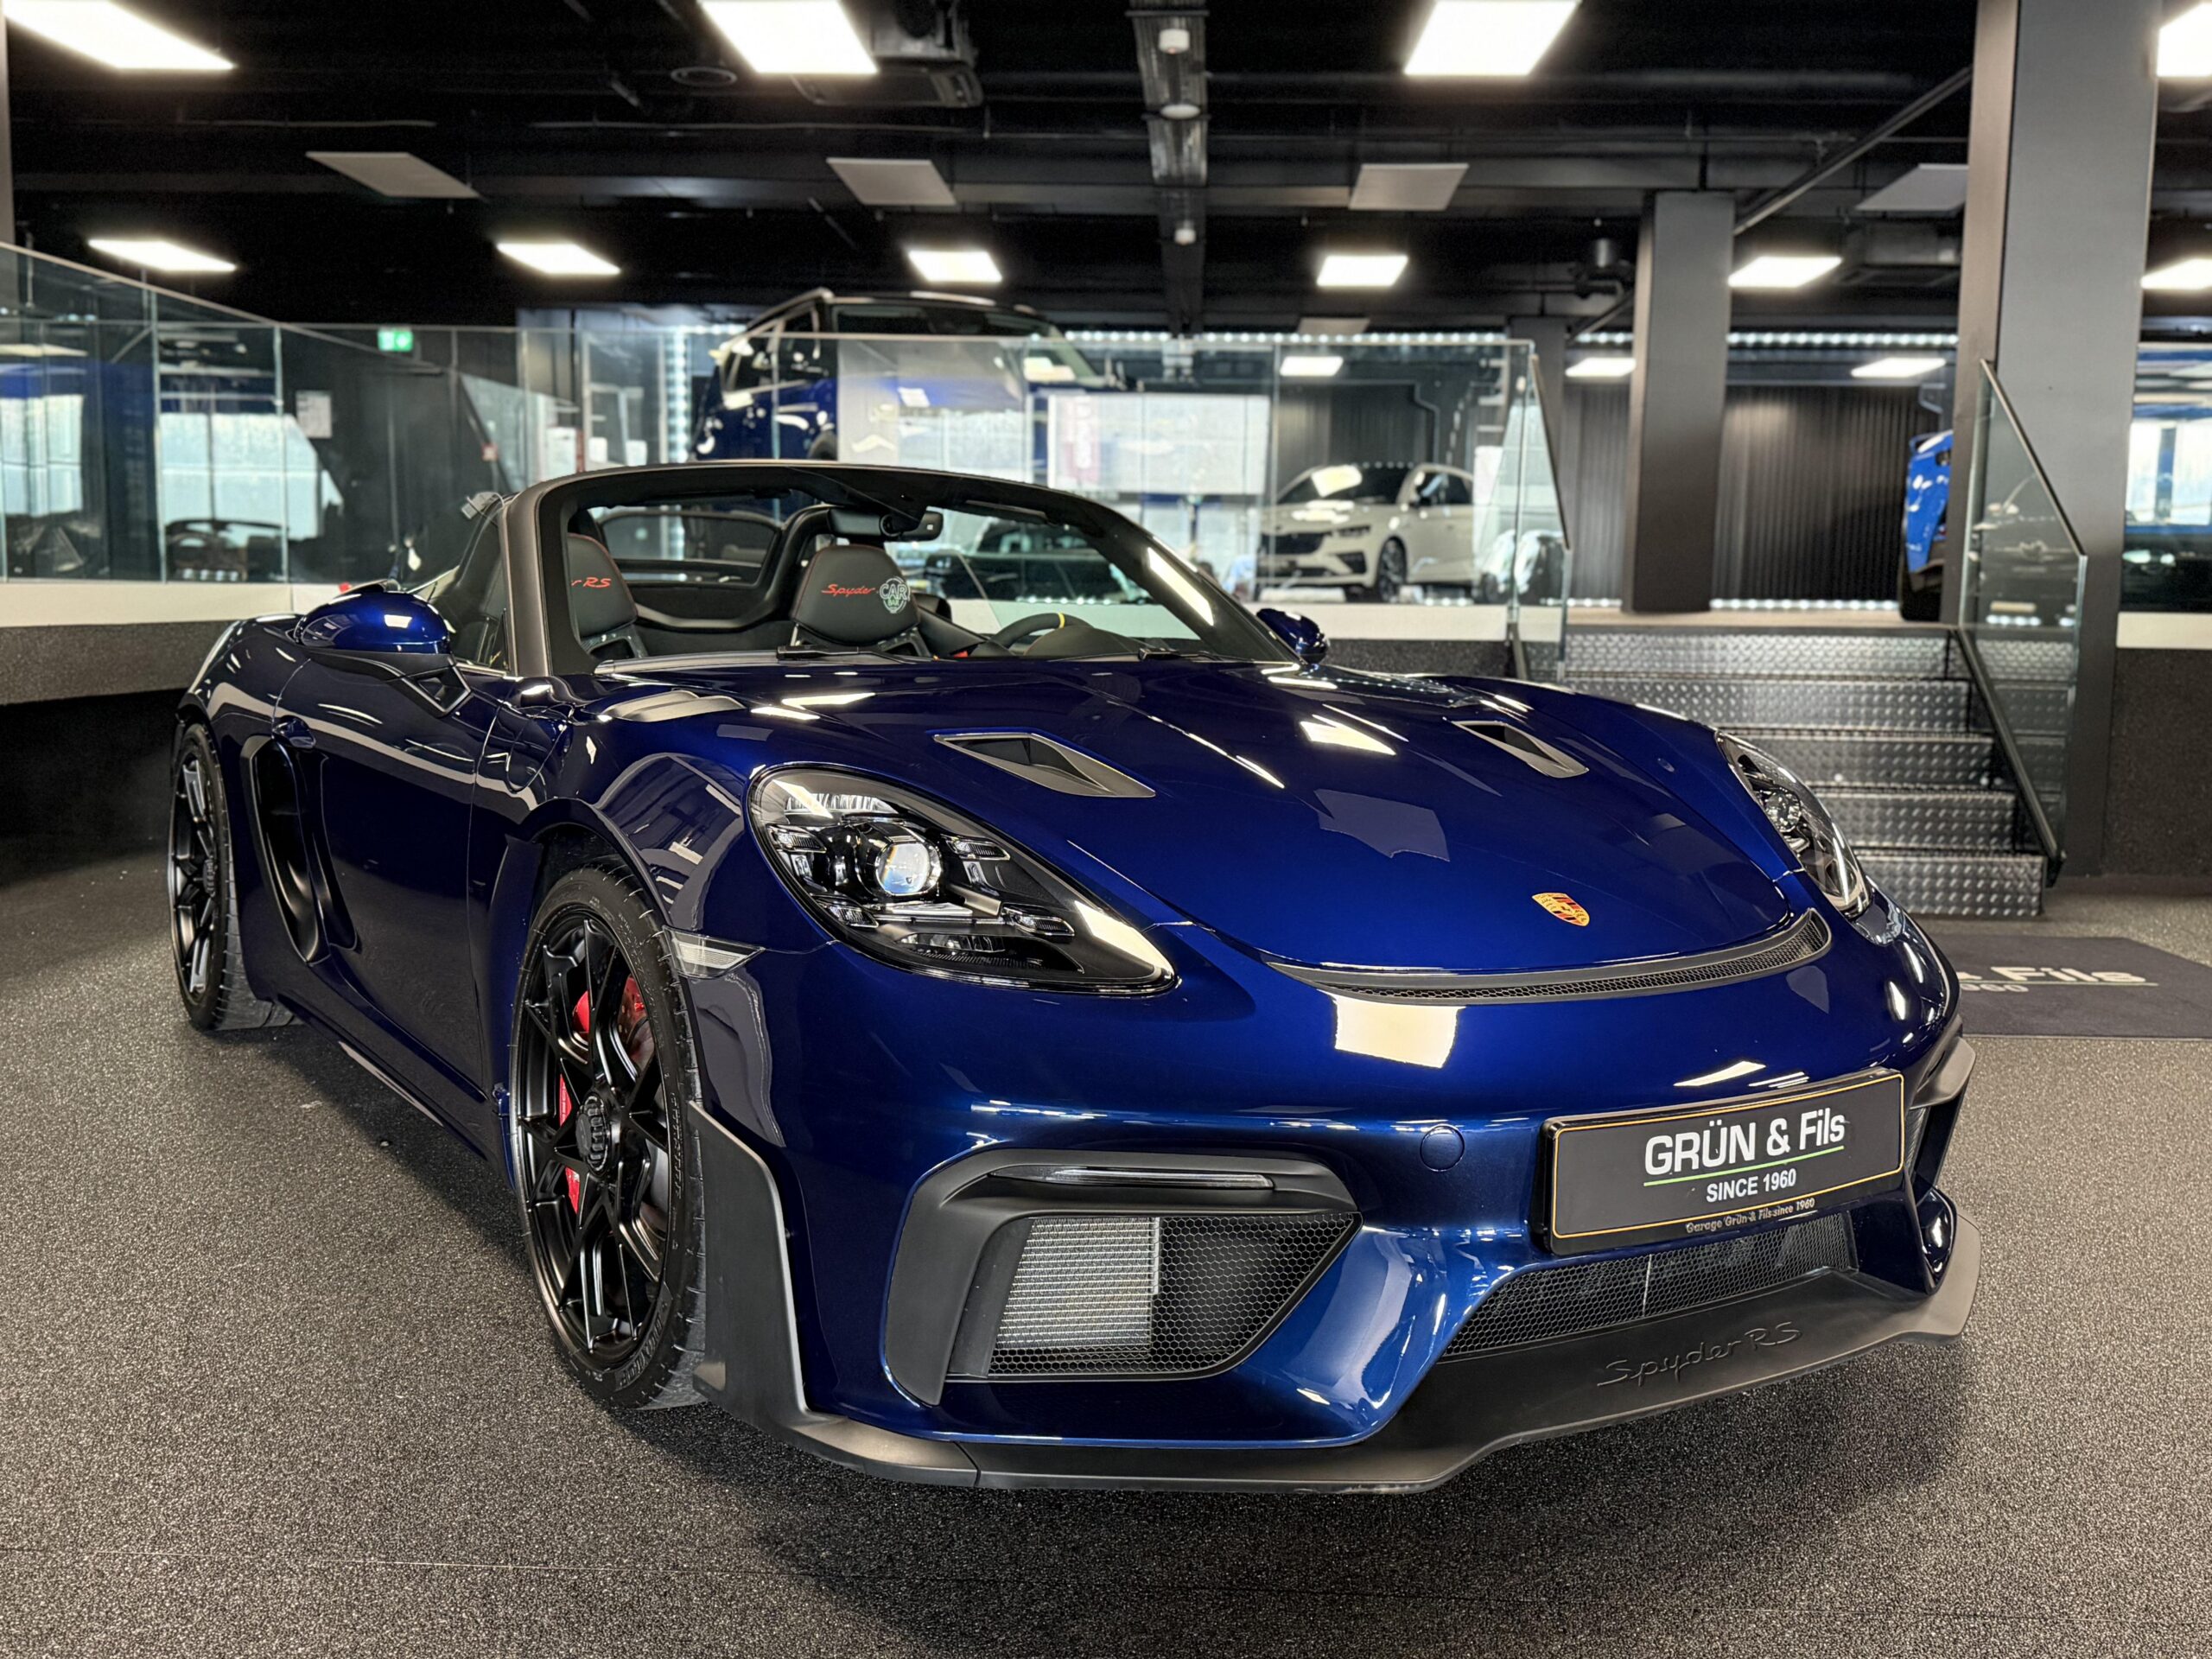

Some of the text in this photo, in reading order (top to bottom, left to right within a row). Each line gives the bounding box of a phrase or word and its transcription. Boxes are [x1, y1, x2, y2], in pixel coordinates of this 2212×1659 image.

[582, 576, 612, 588] RS
[821, 584, 875, 597] Spyder
[879, 582, 908, 601] CAR
[1990, 966, 2146, 982] Fils
[1958, 983, 2029, 992] 960
[1644, 1108, 1846, 1176] GRÜN & Fils
[1706, 1168, 1797, 1202] SINCE 1960
[1686, 1219, 1723, 1234] Garage
[1758, 1209, 1771, 1221] Fils
[1772, 1205, 1794, 1217] since
[1796, 1198, 1815, 1211] 1960
[1597, 1321, 1803, 1387] Spyder RS
